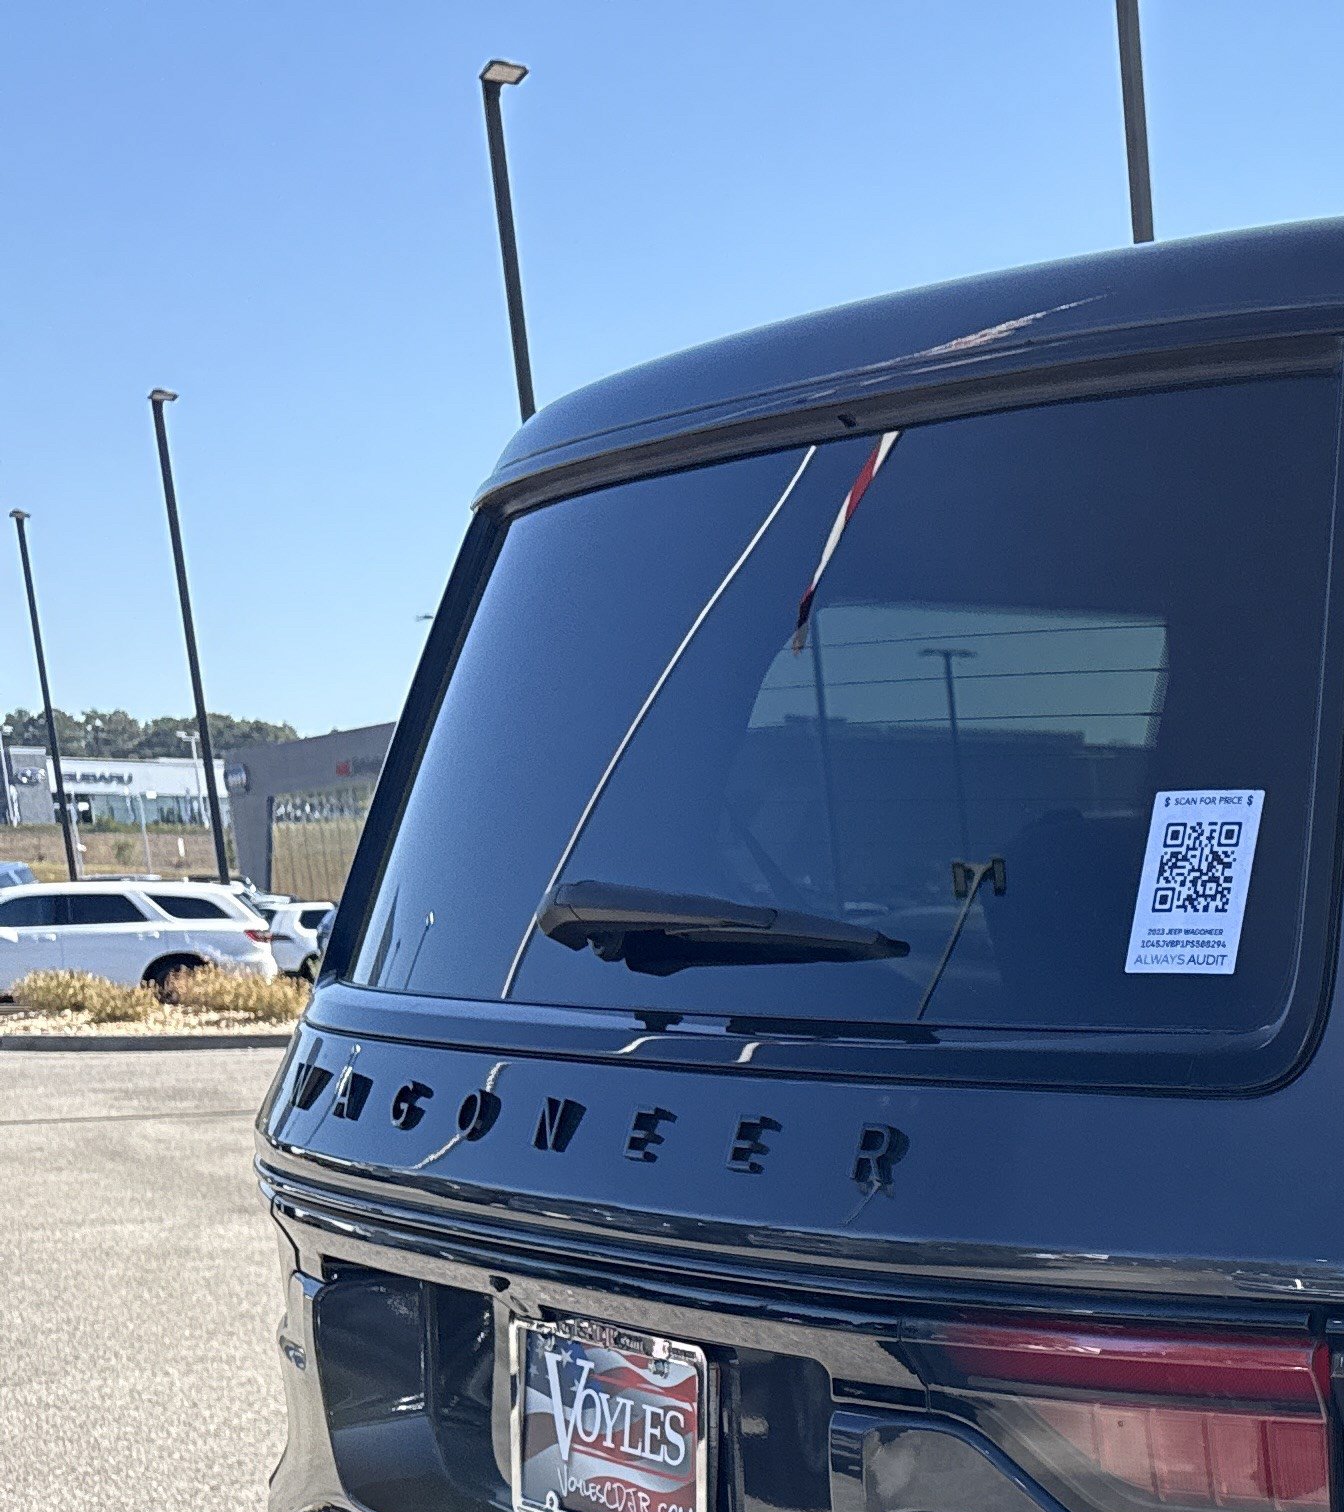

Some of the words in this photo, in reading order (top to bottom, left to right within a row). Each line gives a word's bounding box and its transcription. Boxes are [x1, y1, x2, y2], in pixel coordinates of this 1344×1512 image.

[1174, 797, 1197, 806] SCAN
[1199, 796, 1217, 806] FOR
[1218, 796, 1244, 805] PRICE
[1166, 928, 1183, 936] JEEP
[1134, 953, 1186, 965] ALWAYS
[1186, 954, 1228, 966] AUDIT
[292, 1062, 911, 1195] WAGONEER
[545, 1351, 685, 1467] VOYLES
